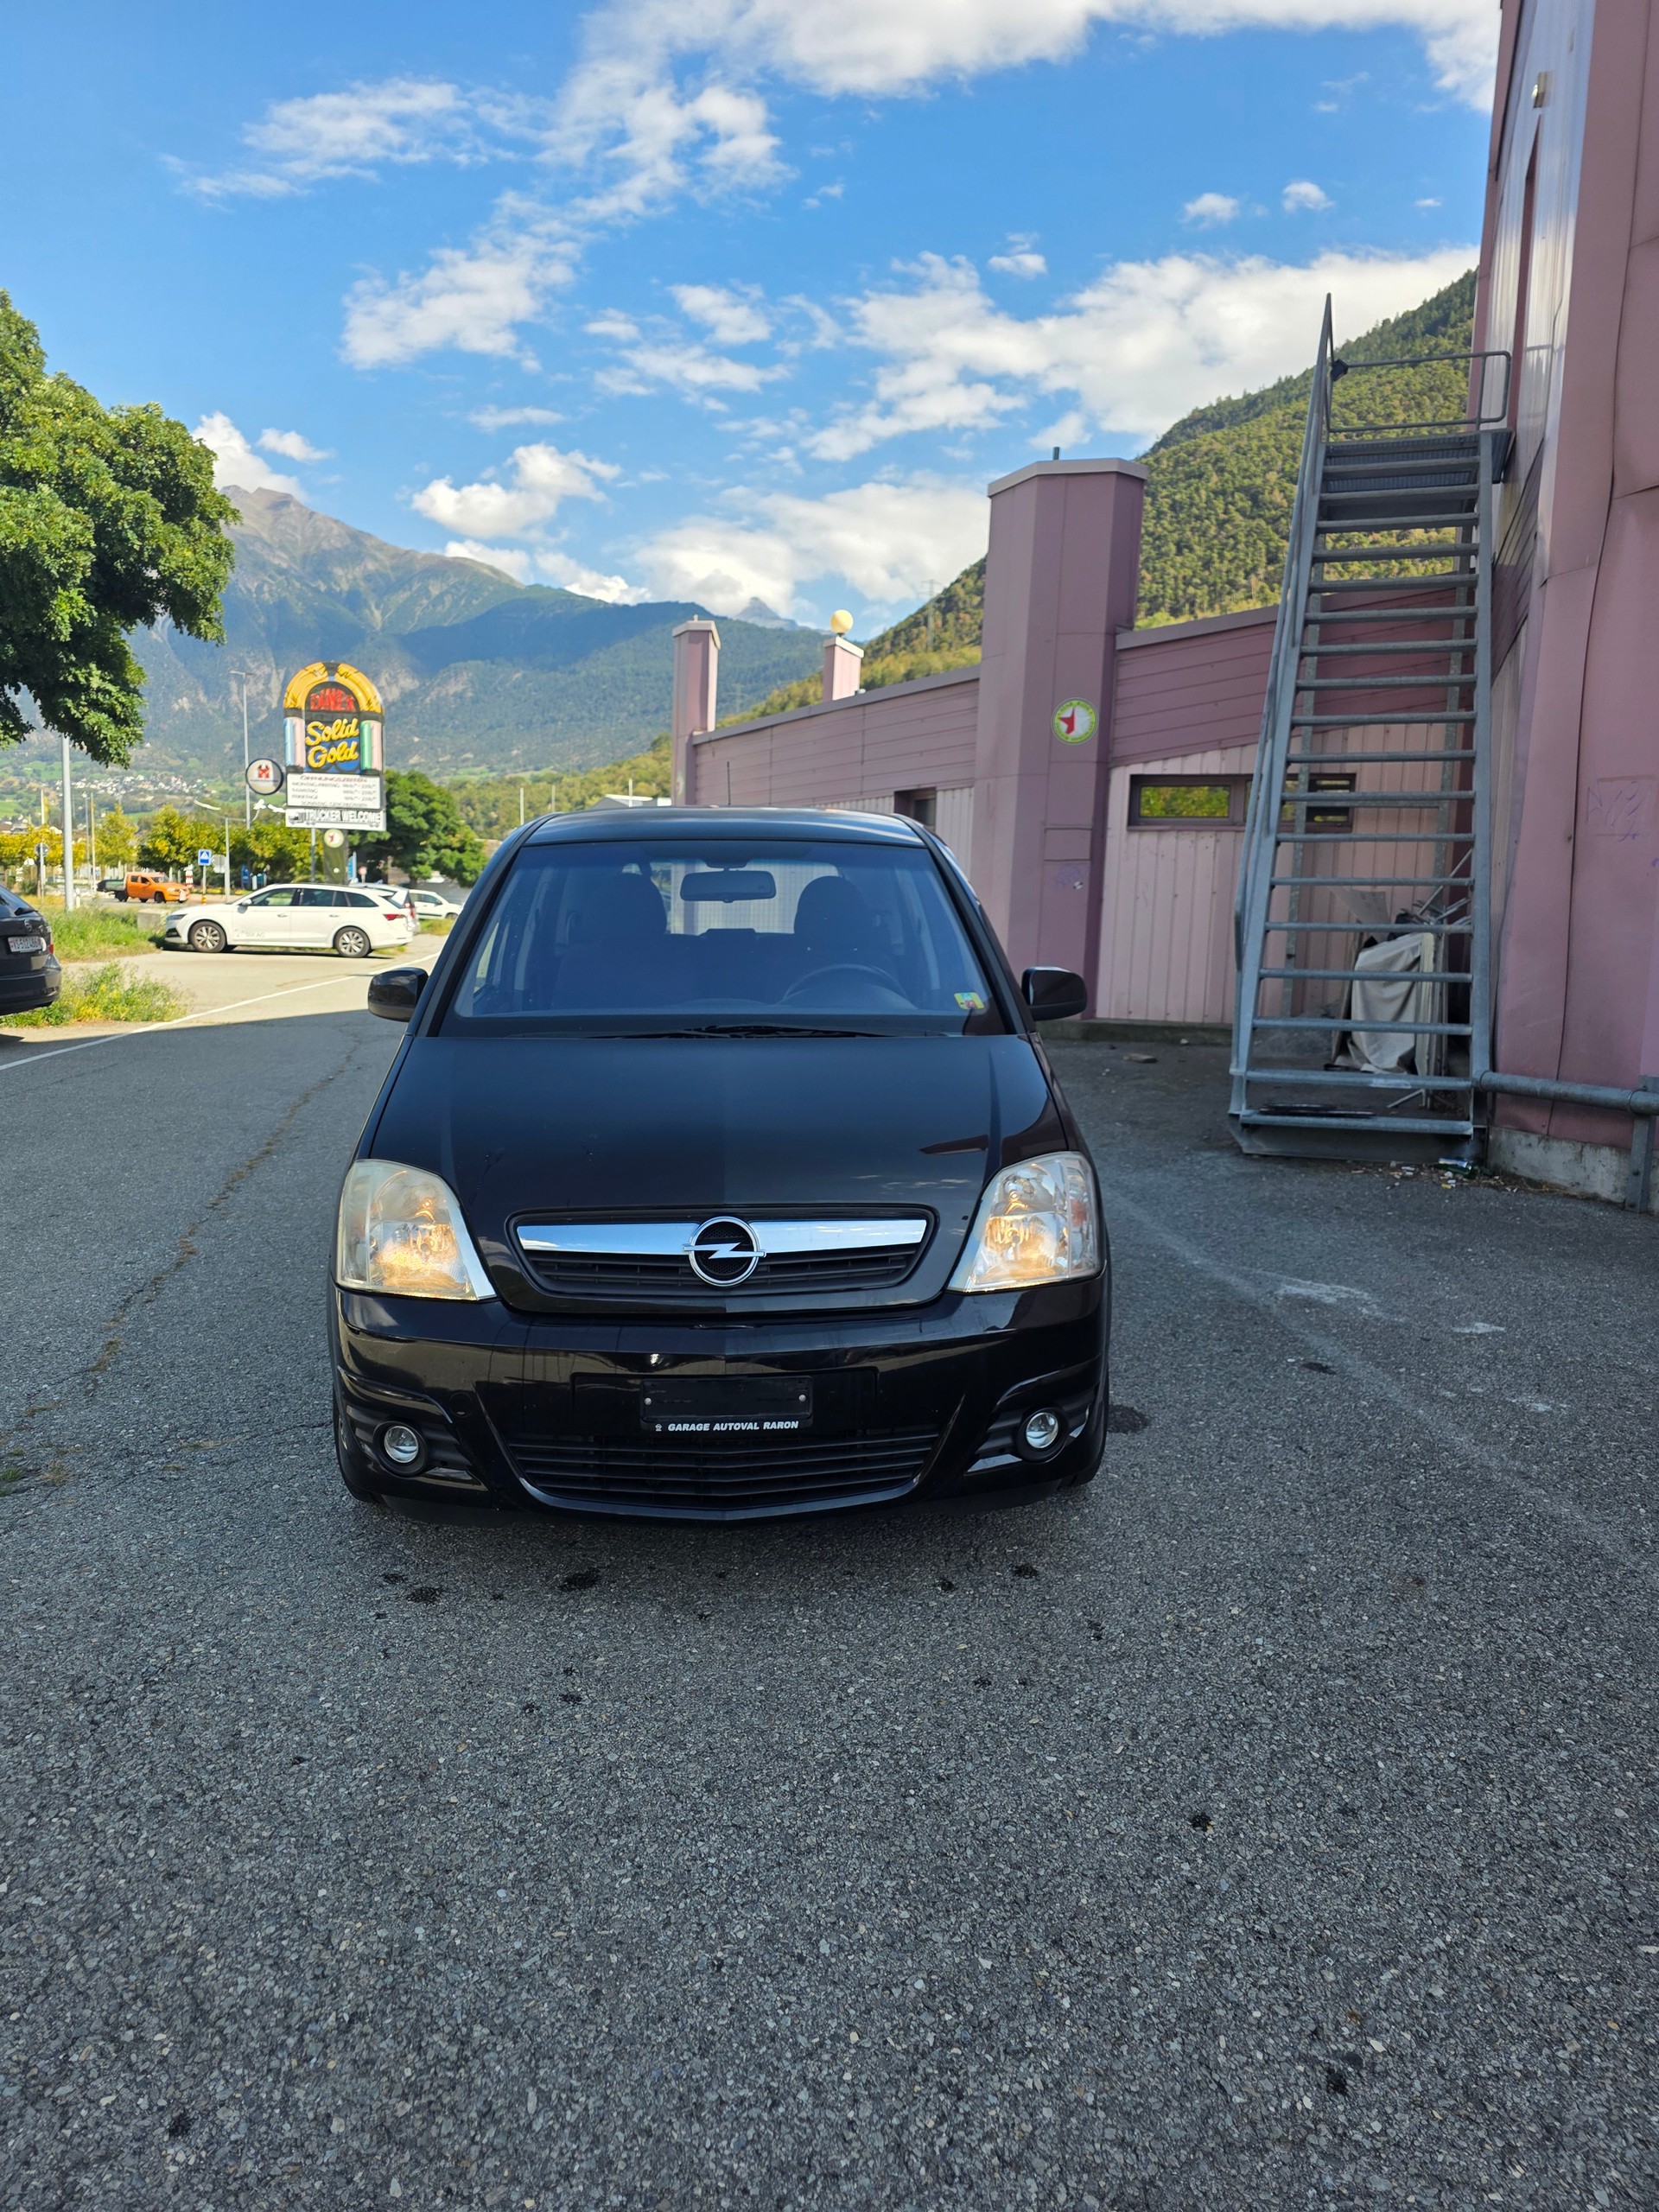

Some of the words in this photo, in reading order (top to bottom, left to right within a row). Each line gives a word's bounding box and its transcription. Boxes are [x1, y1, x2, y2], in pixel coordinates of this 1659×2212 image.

[309, 688, 356, 712] DINER
[305, 717, 359, 746] Solid
[308, 741, 359, 768] Gold
[304, 809, 341, 823] TRUCKER
[341, 810, 381, 823] WELCOME
[667, 1423, 710, 1432] GARAGE
[713, 1421, 760, 1431] AUTOVAL
[763, 1421, 799, 1430] RARON
